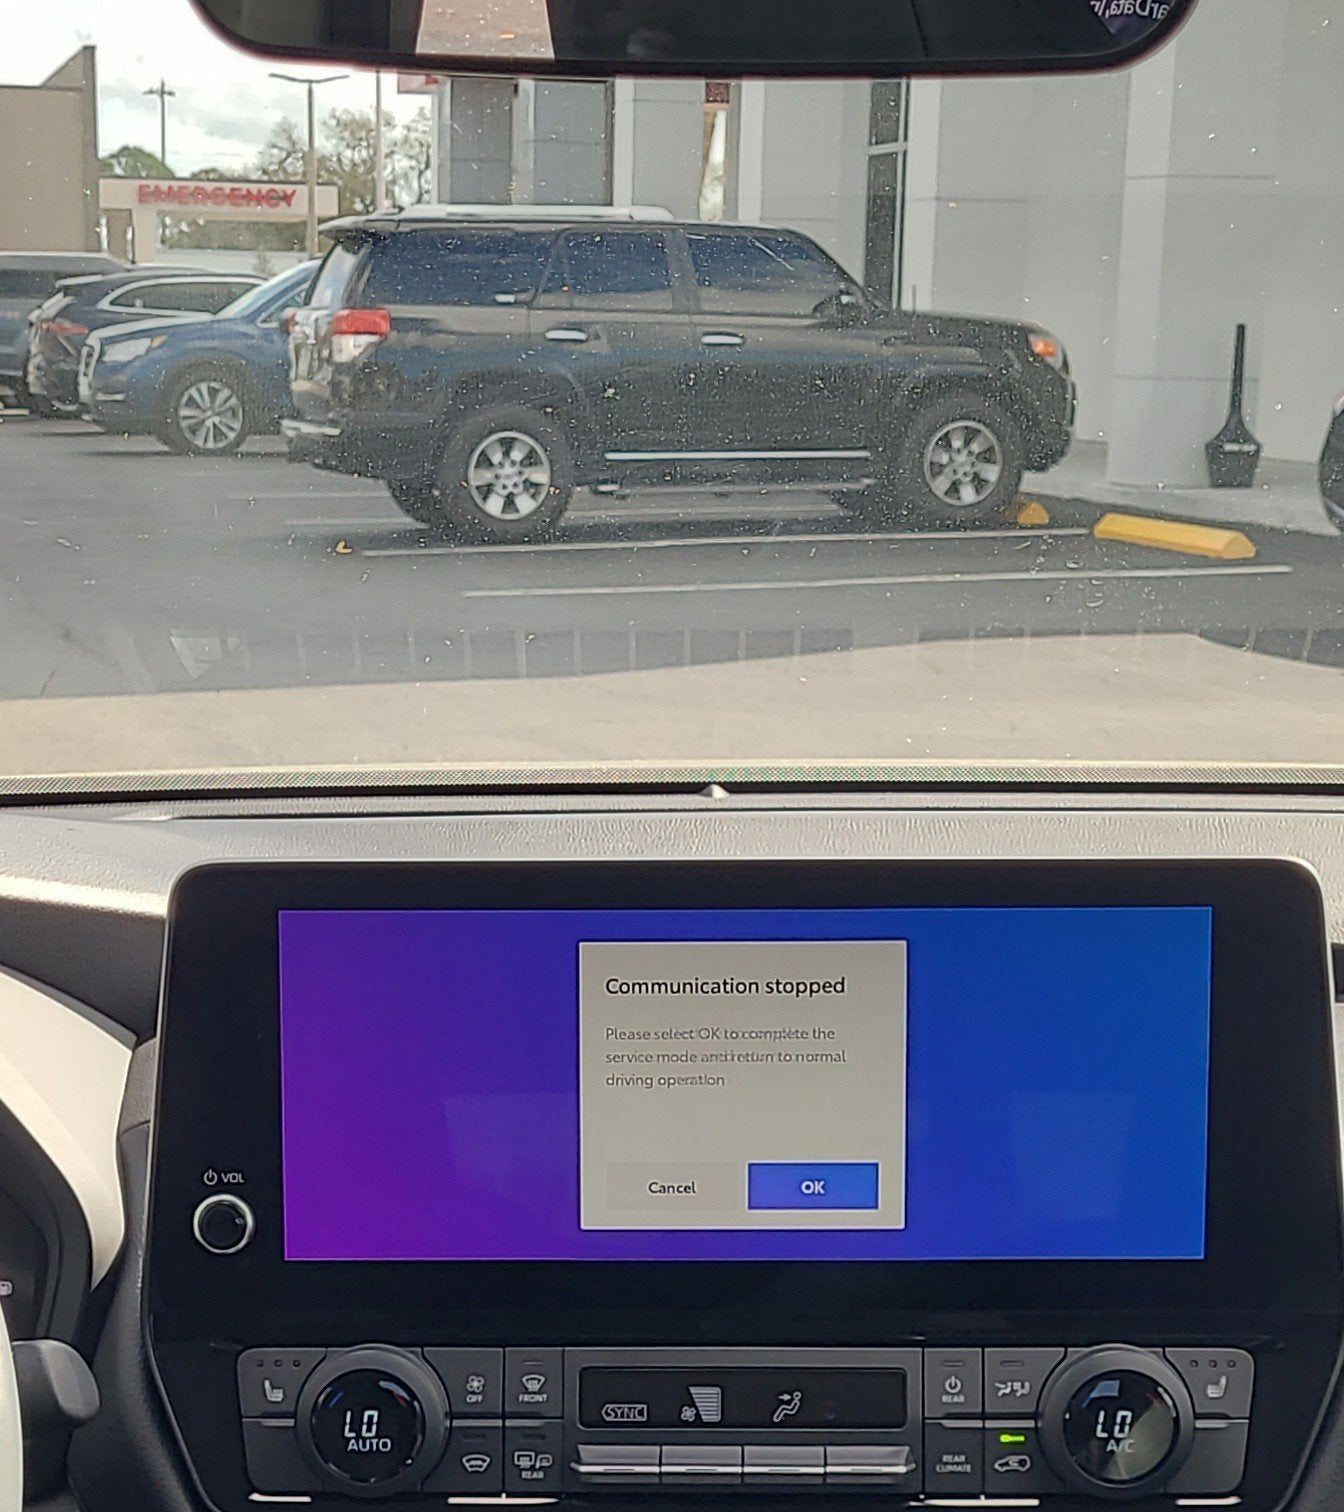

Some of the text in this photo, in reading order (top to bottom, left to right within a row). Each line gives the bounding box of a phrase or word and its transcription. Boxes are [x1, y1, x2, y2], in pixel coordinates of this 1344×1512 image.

[137, 184, 297, 209] EMERGENCY
[605, 977, 846, 998] Communication stopped
[605, 1027, 836, 1044] Please select OK to complete the
[605, 1050, 653, 1064] service
[656, 1049, 698, 1064] mode
[777, 1052, 793, 1064] to
[795, 1049, 847, 1064] normal
[605, 1073, 726, 1090] driving operation
[221, 1172, 246, 1183] VOL
[647, 1181, 697, 1195] Cancel
[800, 1180, 827, 1195] OK
[518, 1393, 548, 1403] FRONT
[605, 1406, 646, 1421] SYNC
[347, 1438, 392, 1452] AUTO
[1106, 1438, 1136, 1453] A/C
[520, 1470, 545, 1480] REAR
